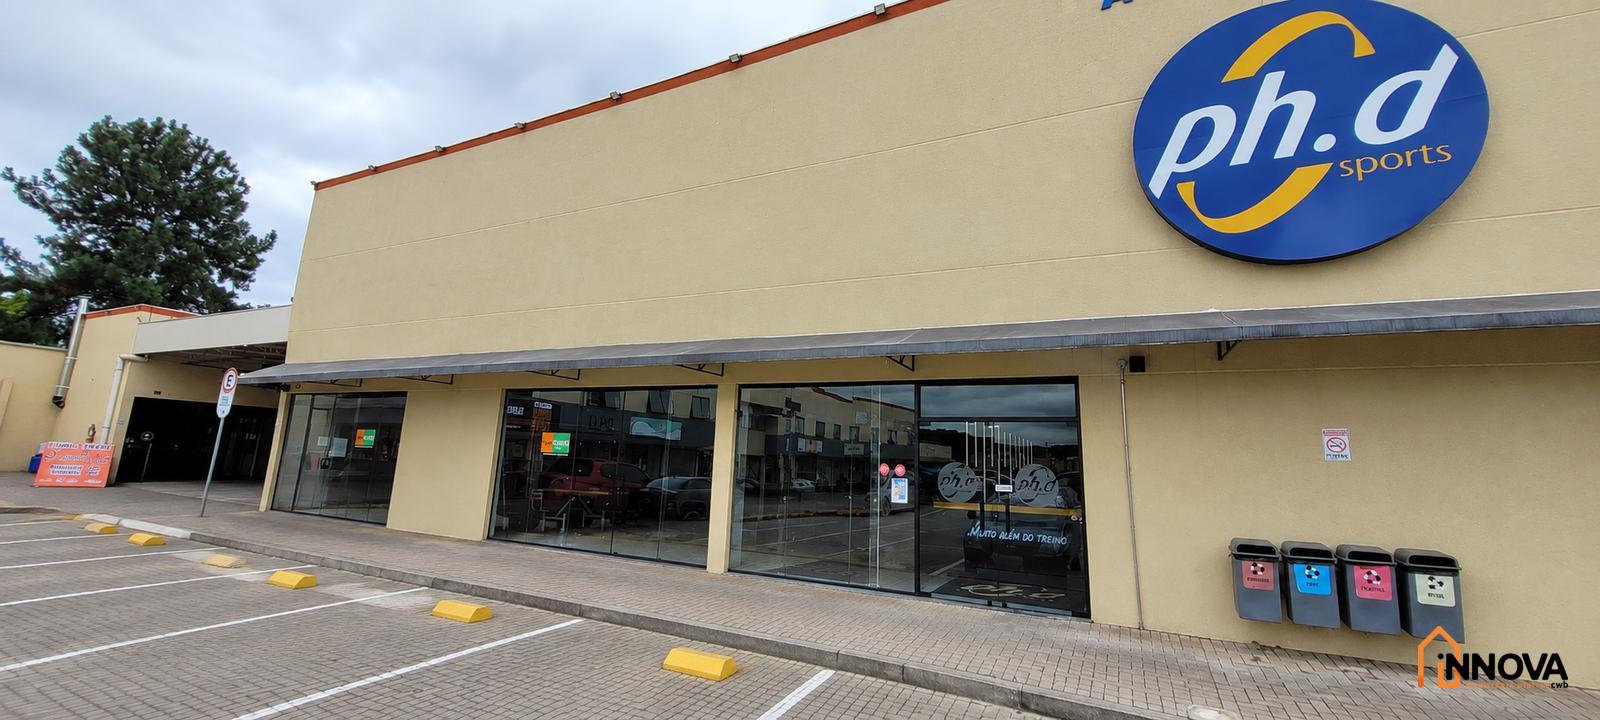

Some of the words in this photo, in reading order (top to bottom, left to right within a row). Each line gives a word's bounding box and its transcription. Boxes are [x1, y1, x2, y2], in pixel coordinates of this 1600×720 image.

[1148, 43, 1459, 199] ph.d
[1340, 144, 1452, 181] sports
[226, 374, 234, 387] E
[999, 528, 1020, 541] ALÉM
[1022, 533, 1034, 542] DO
[1036, 534, 1067, 545] TREINO
